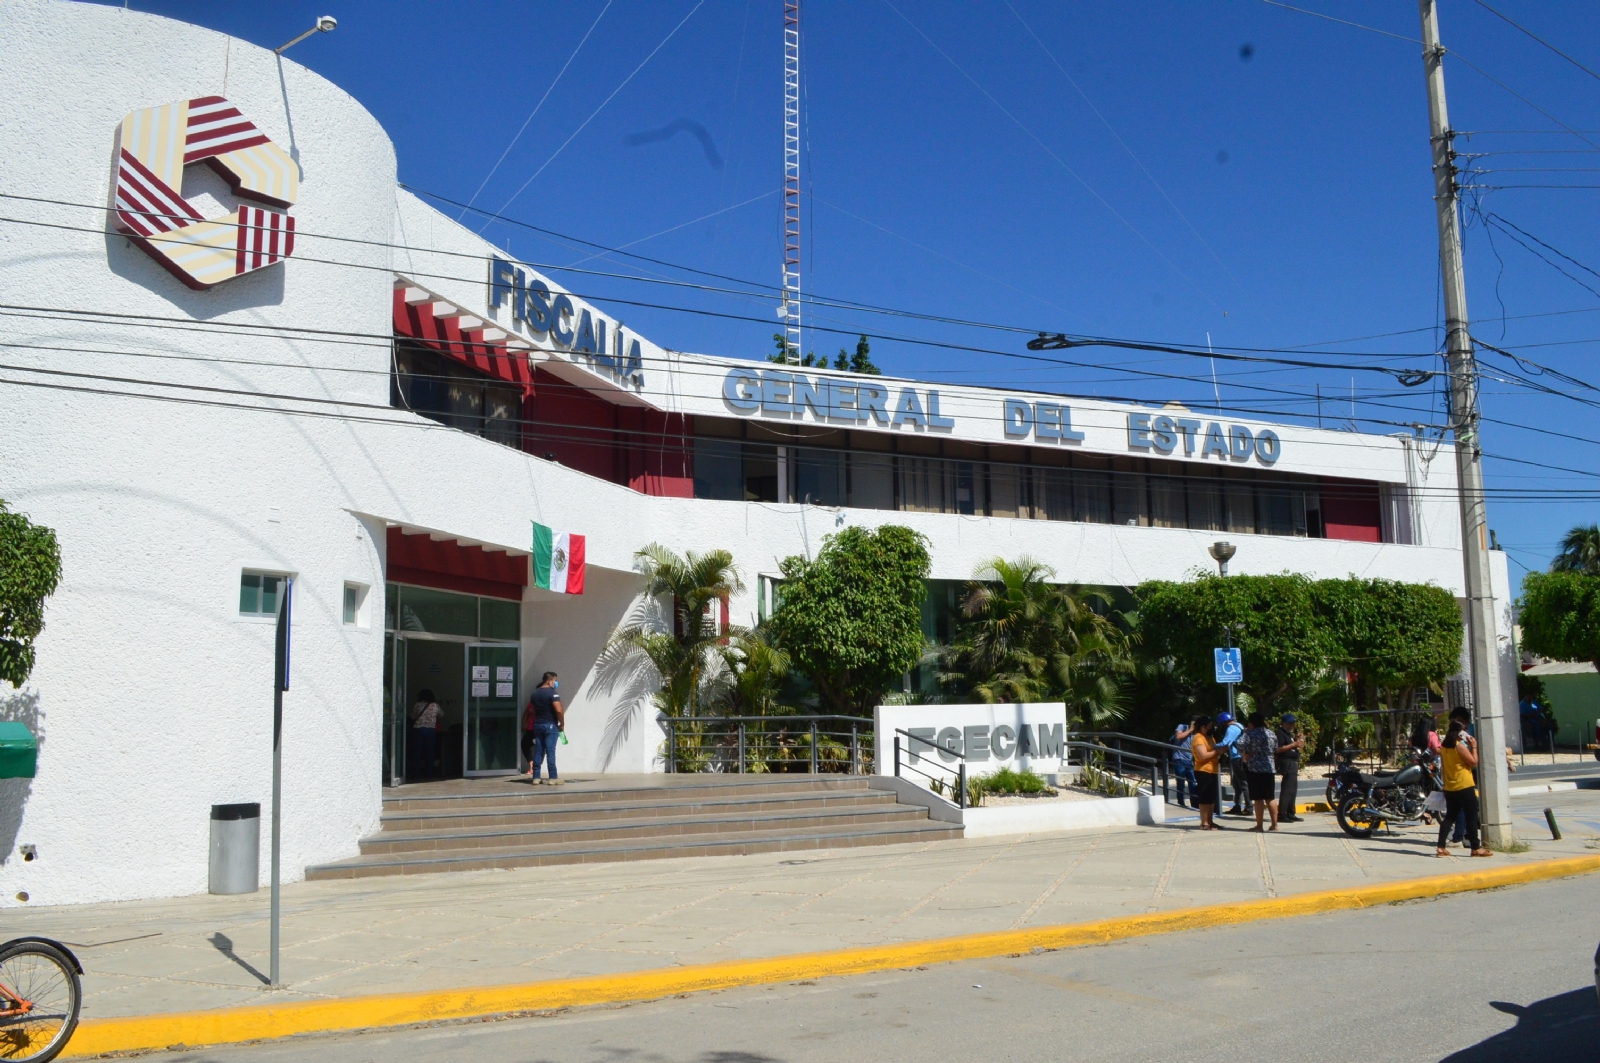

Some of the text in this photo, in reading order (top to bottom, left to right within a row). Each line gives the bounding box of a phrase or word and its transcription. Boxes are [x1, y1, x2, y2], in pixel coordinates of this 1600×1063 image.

[488, 252, 1281, 464] FISCALÍA GENERAL DEL ESTADO
[908, 723, 1064, 765] FGECAM
